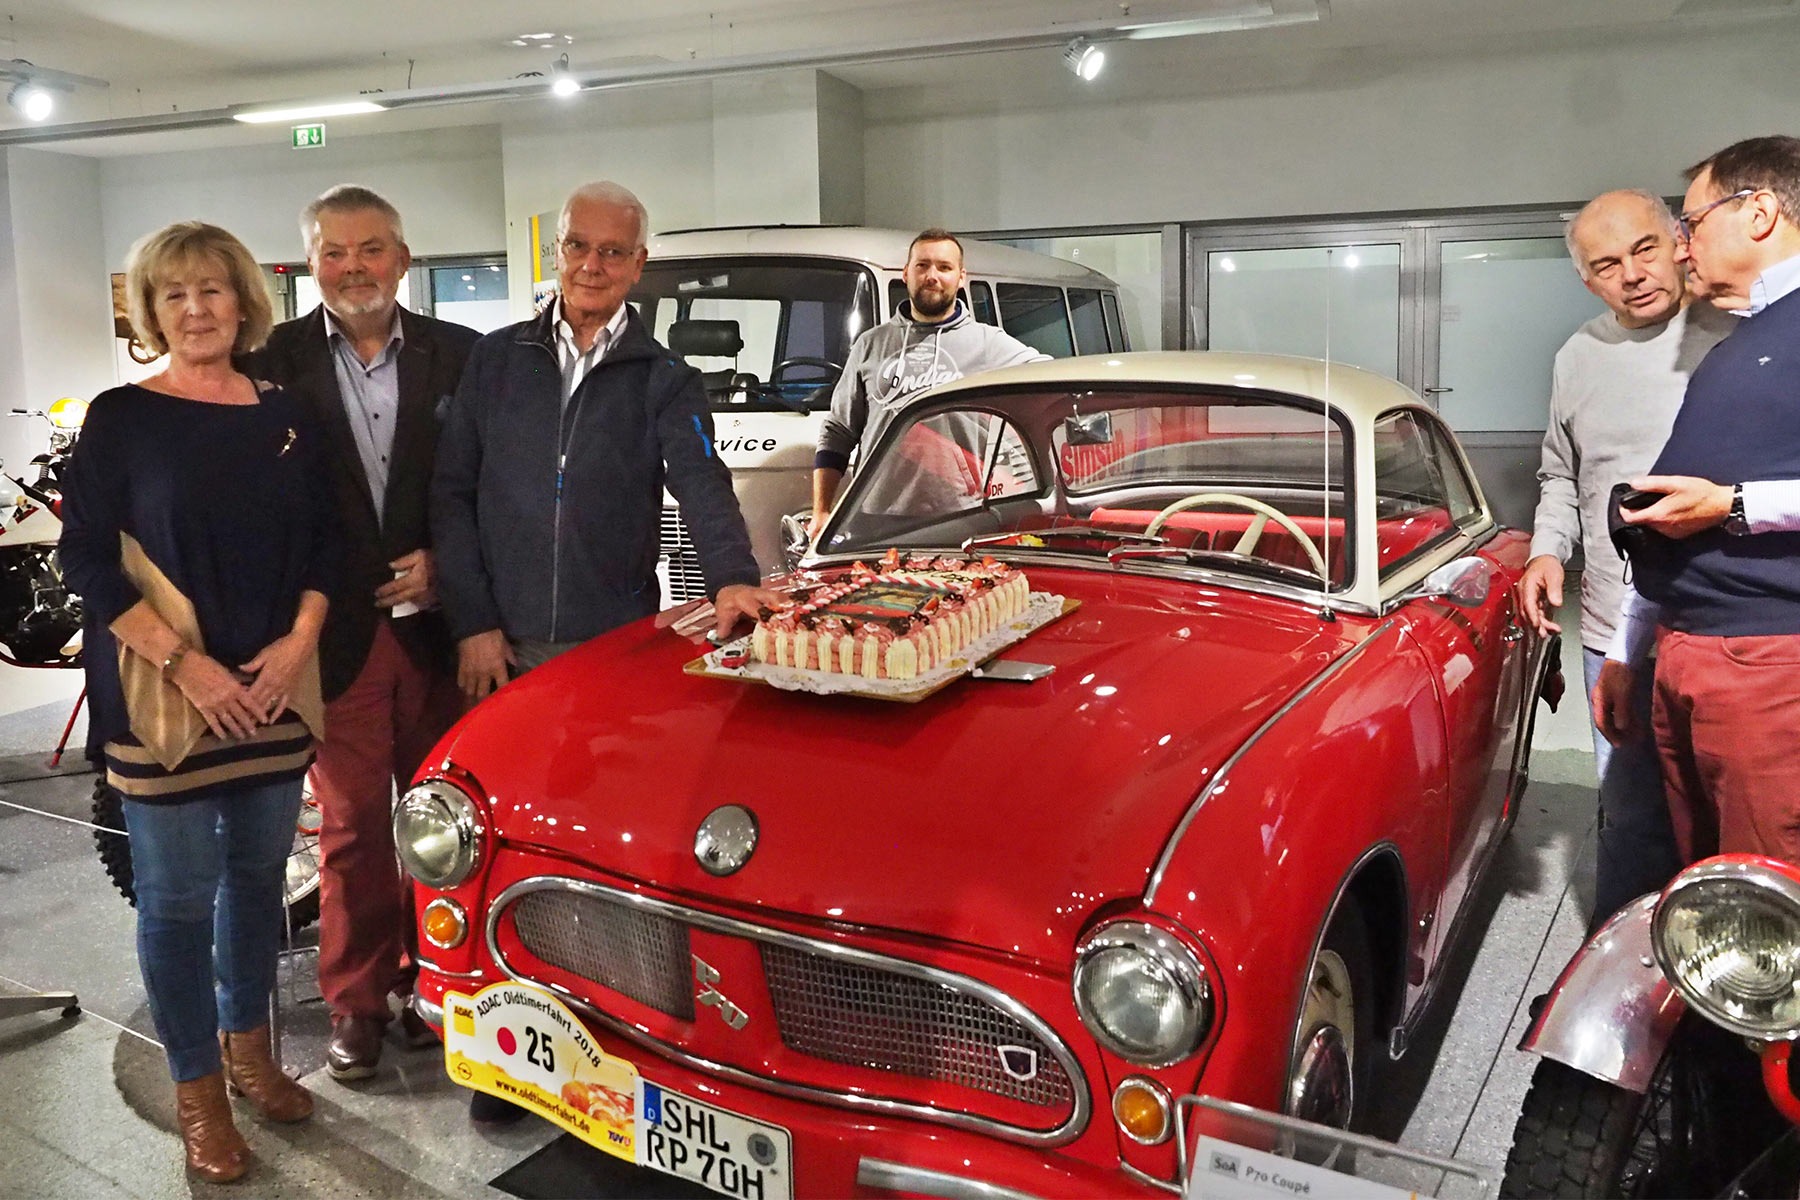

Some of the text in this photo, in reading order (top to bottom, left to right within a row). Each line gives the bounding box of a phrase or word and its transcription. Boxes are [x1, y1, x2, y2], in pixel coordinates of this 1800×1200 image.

[714, 436, 777, 452] vice
[453, 1005, 474, 1020] ADAC
[477, 991, 602, 1068] ADAC Oldtimerfahrt 2018
[525, 1026, 555, 1073] 25
[495, 1080, 590, 1134] www.oldtimerfahrt.de
[647, 1107, 656, 1120] D
[664, 1098, 730, 1153] SHL
[647, 1129, 688, 1171] RP
[1272, 1173, 1311, 1194] Coupé
